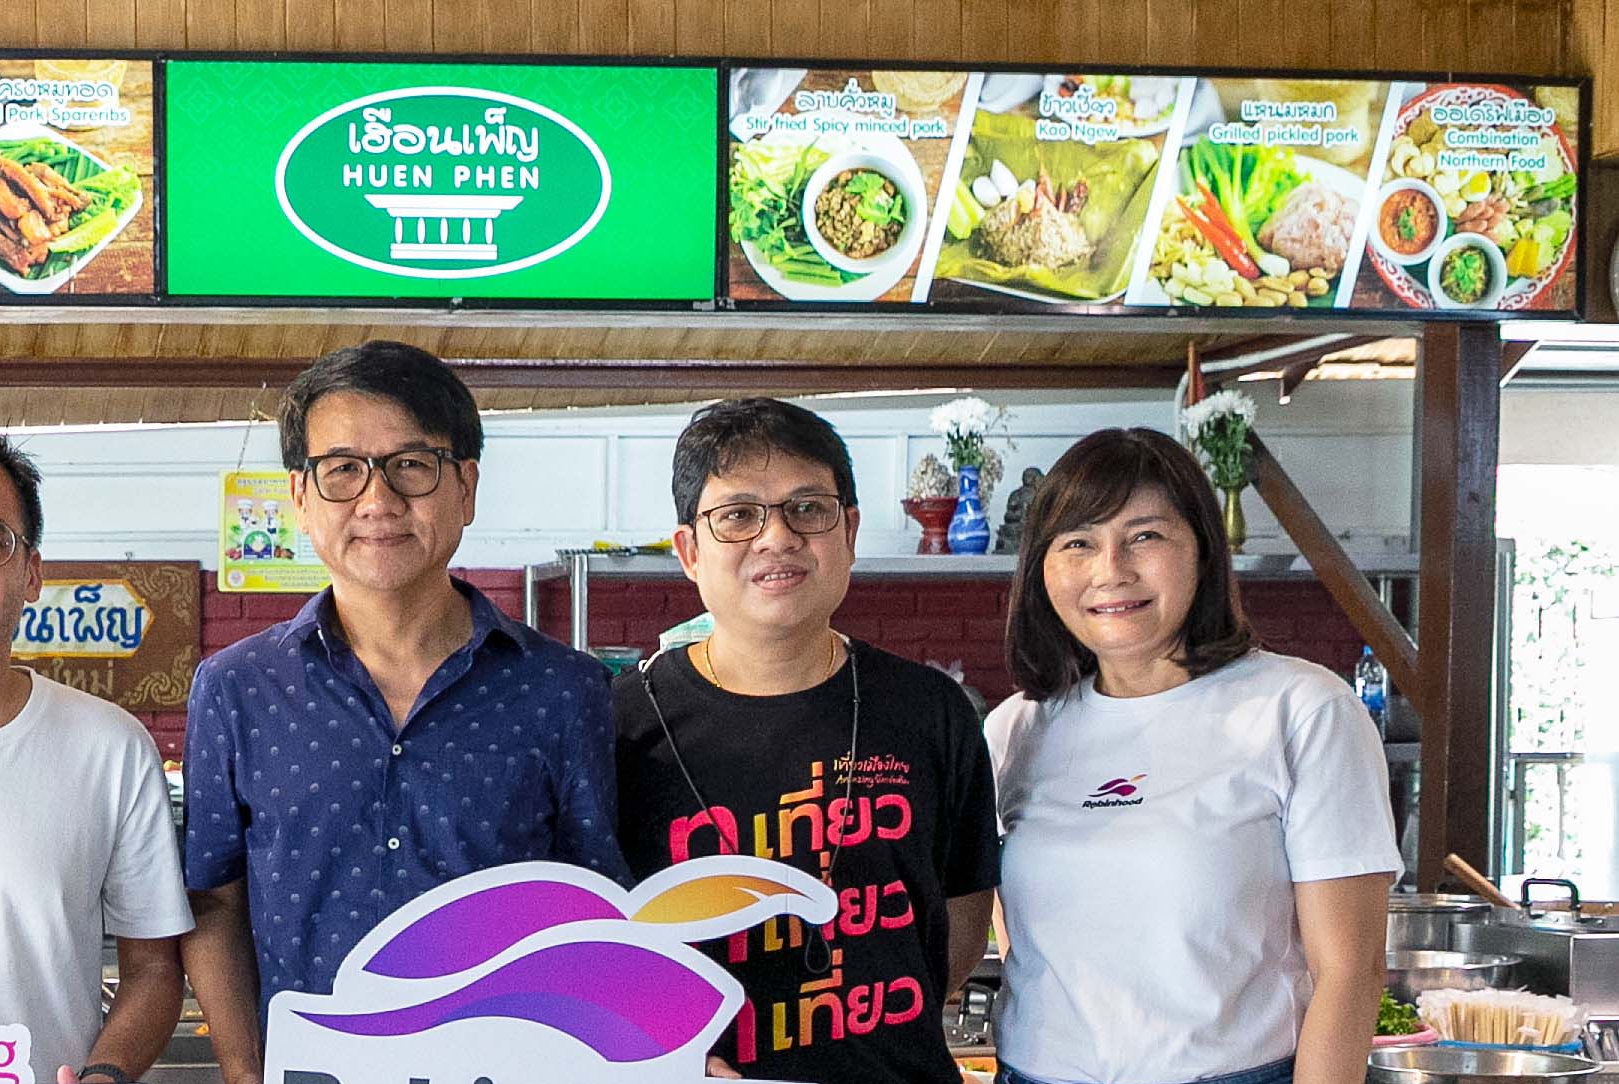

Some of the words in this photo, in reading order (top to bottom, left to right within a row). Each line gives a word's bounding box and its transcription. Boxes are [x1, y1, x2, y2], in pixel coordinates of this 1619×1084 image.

[798, 79, 894, 116] ลาบคั่วหมู
[8, 107, 43, 121] Pork
[51, 107, 127, 124] Spareribs
[348, 106, 539, 162] เฮือนเพ็ญ
[746, 116, 768, 130] Stir
[774, 116, 807, 130] fried
[813, 117, 850, 134] Spicy
[855, 117, 907, 133] minced
[912, 119, 946, 137] pork
[1039, 123, 1067, 136] Kao
[1212, 126, 1260, 140] Grilled
[1267, 126, 1319, 143] pickled
[1325, 128, 1359, 144] pork
[1447, 130, 1539, 145] Combination
[1439, 155, 1505, 167] Northern
[1510, 155, 1546, 169] Food
[342, 163, 433, 189] HUEN
[453, 165, 539, 190] PHEN
[12, 584, 144, 649] นเพ็ญ
[1081, 796, 1144, 810] Robinhood
